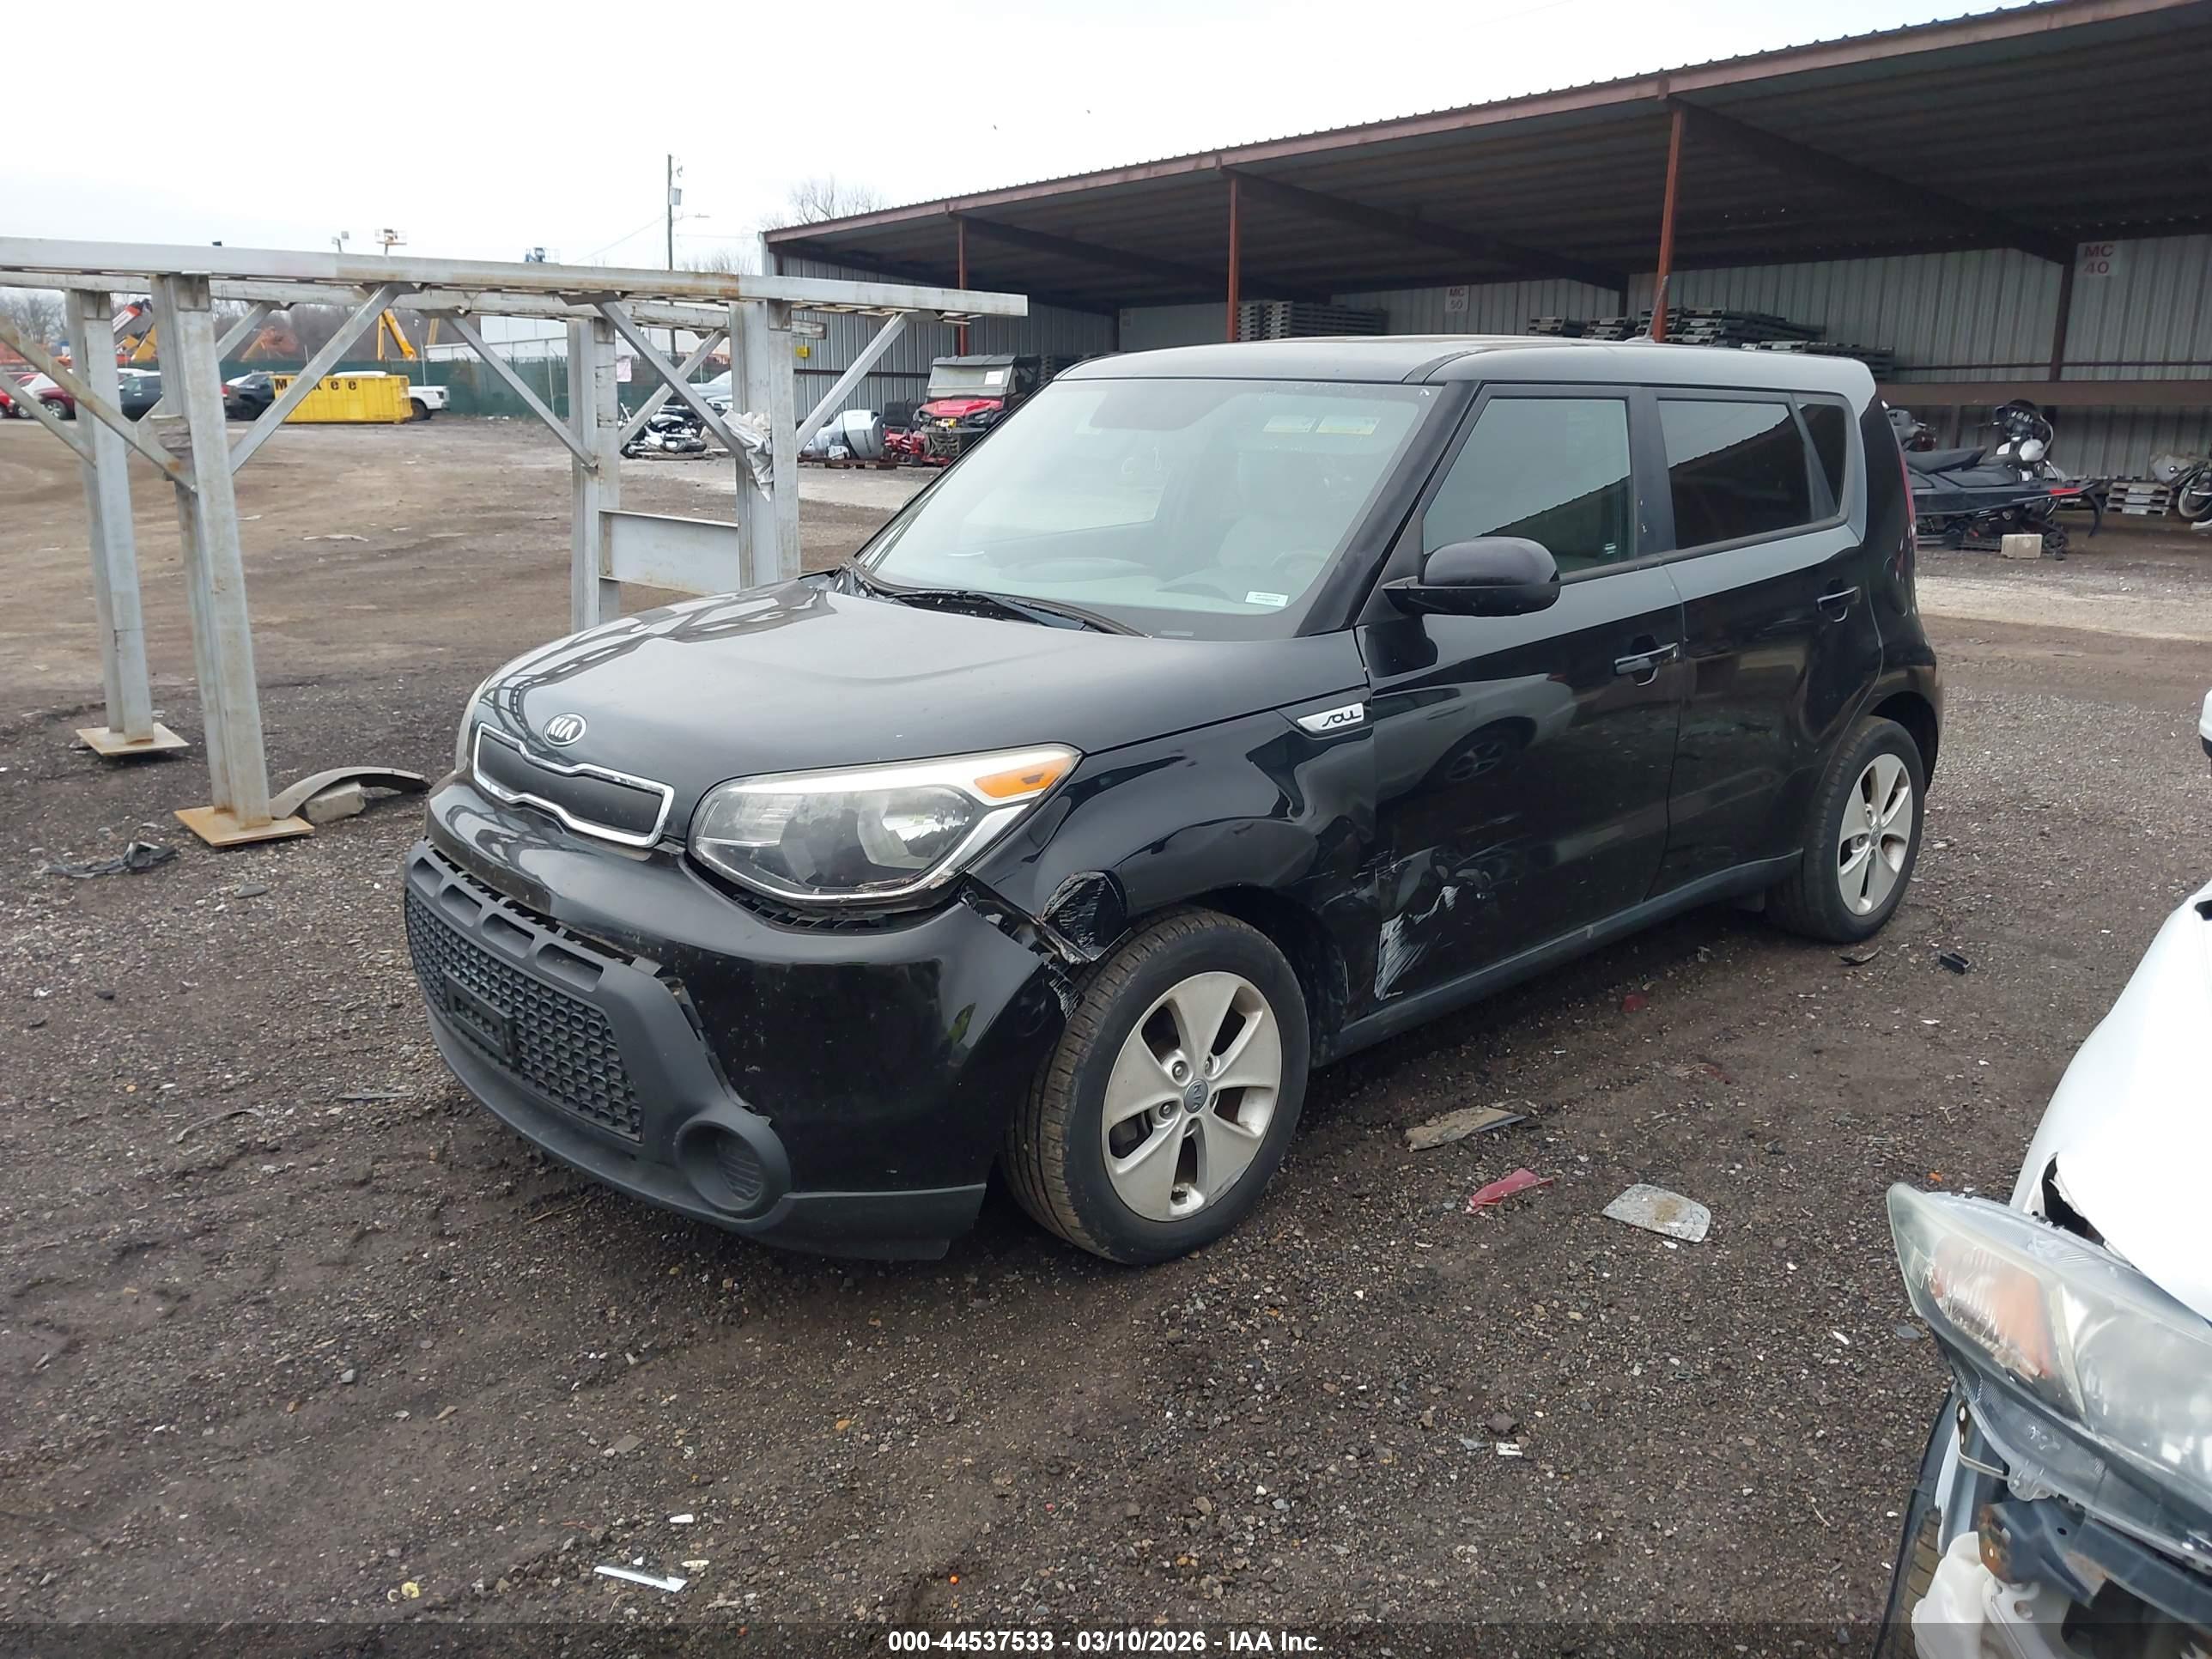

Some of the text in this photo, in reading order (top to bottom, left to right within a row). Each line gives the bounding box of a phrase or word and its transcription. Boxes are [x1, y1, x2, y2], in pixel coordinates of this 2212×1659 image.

[2084, 245, 2114, 257] MC
[2084, 261, 2110, 274] 40
[1322, 709, 1363, 727] SOUL
[546, 716, 579, 740] KIA
